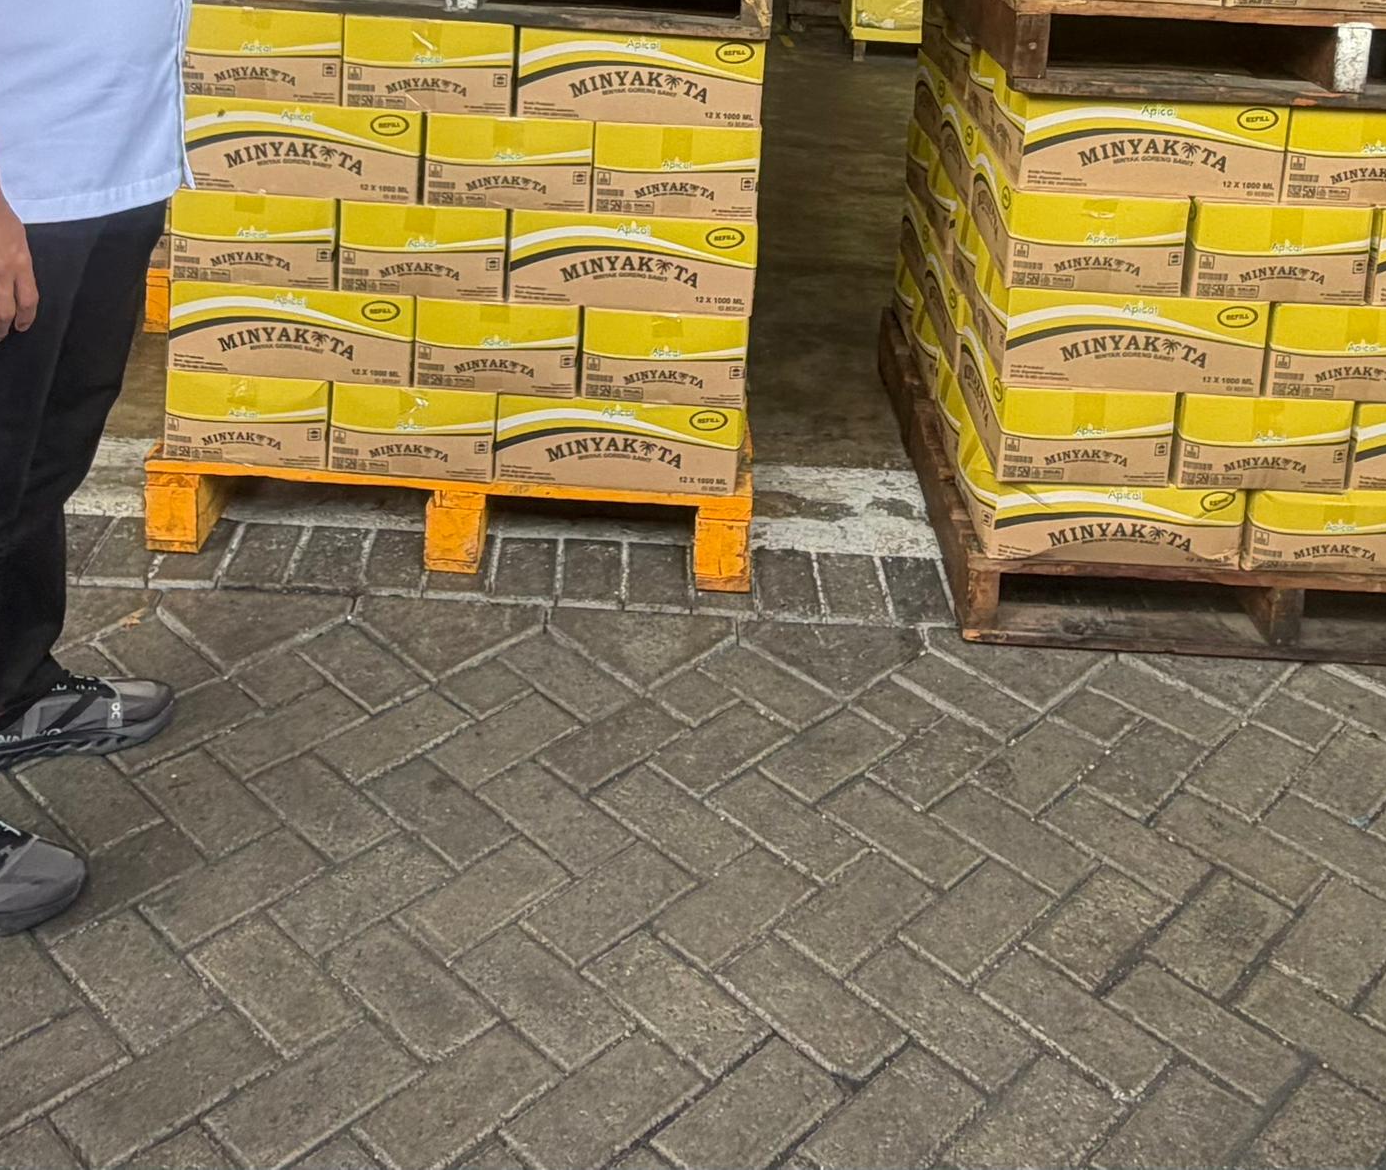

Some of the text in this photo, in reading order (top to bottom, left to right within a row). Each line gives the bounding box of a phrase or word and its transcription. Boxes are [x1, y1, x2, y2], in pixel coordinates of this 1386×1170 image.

[724, 49, 746, 57] REFILL
[1246, 115, 1270, 123] REFILL
[1226, 313, 1250, 321] REFILL
